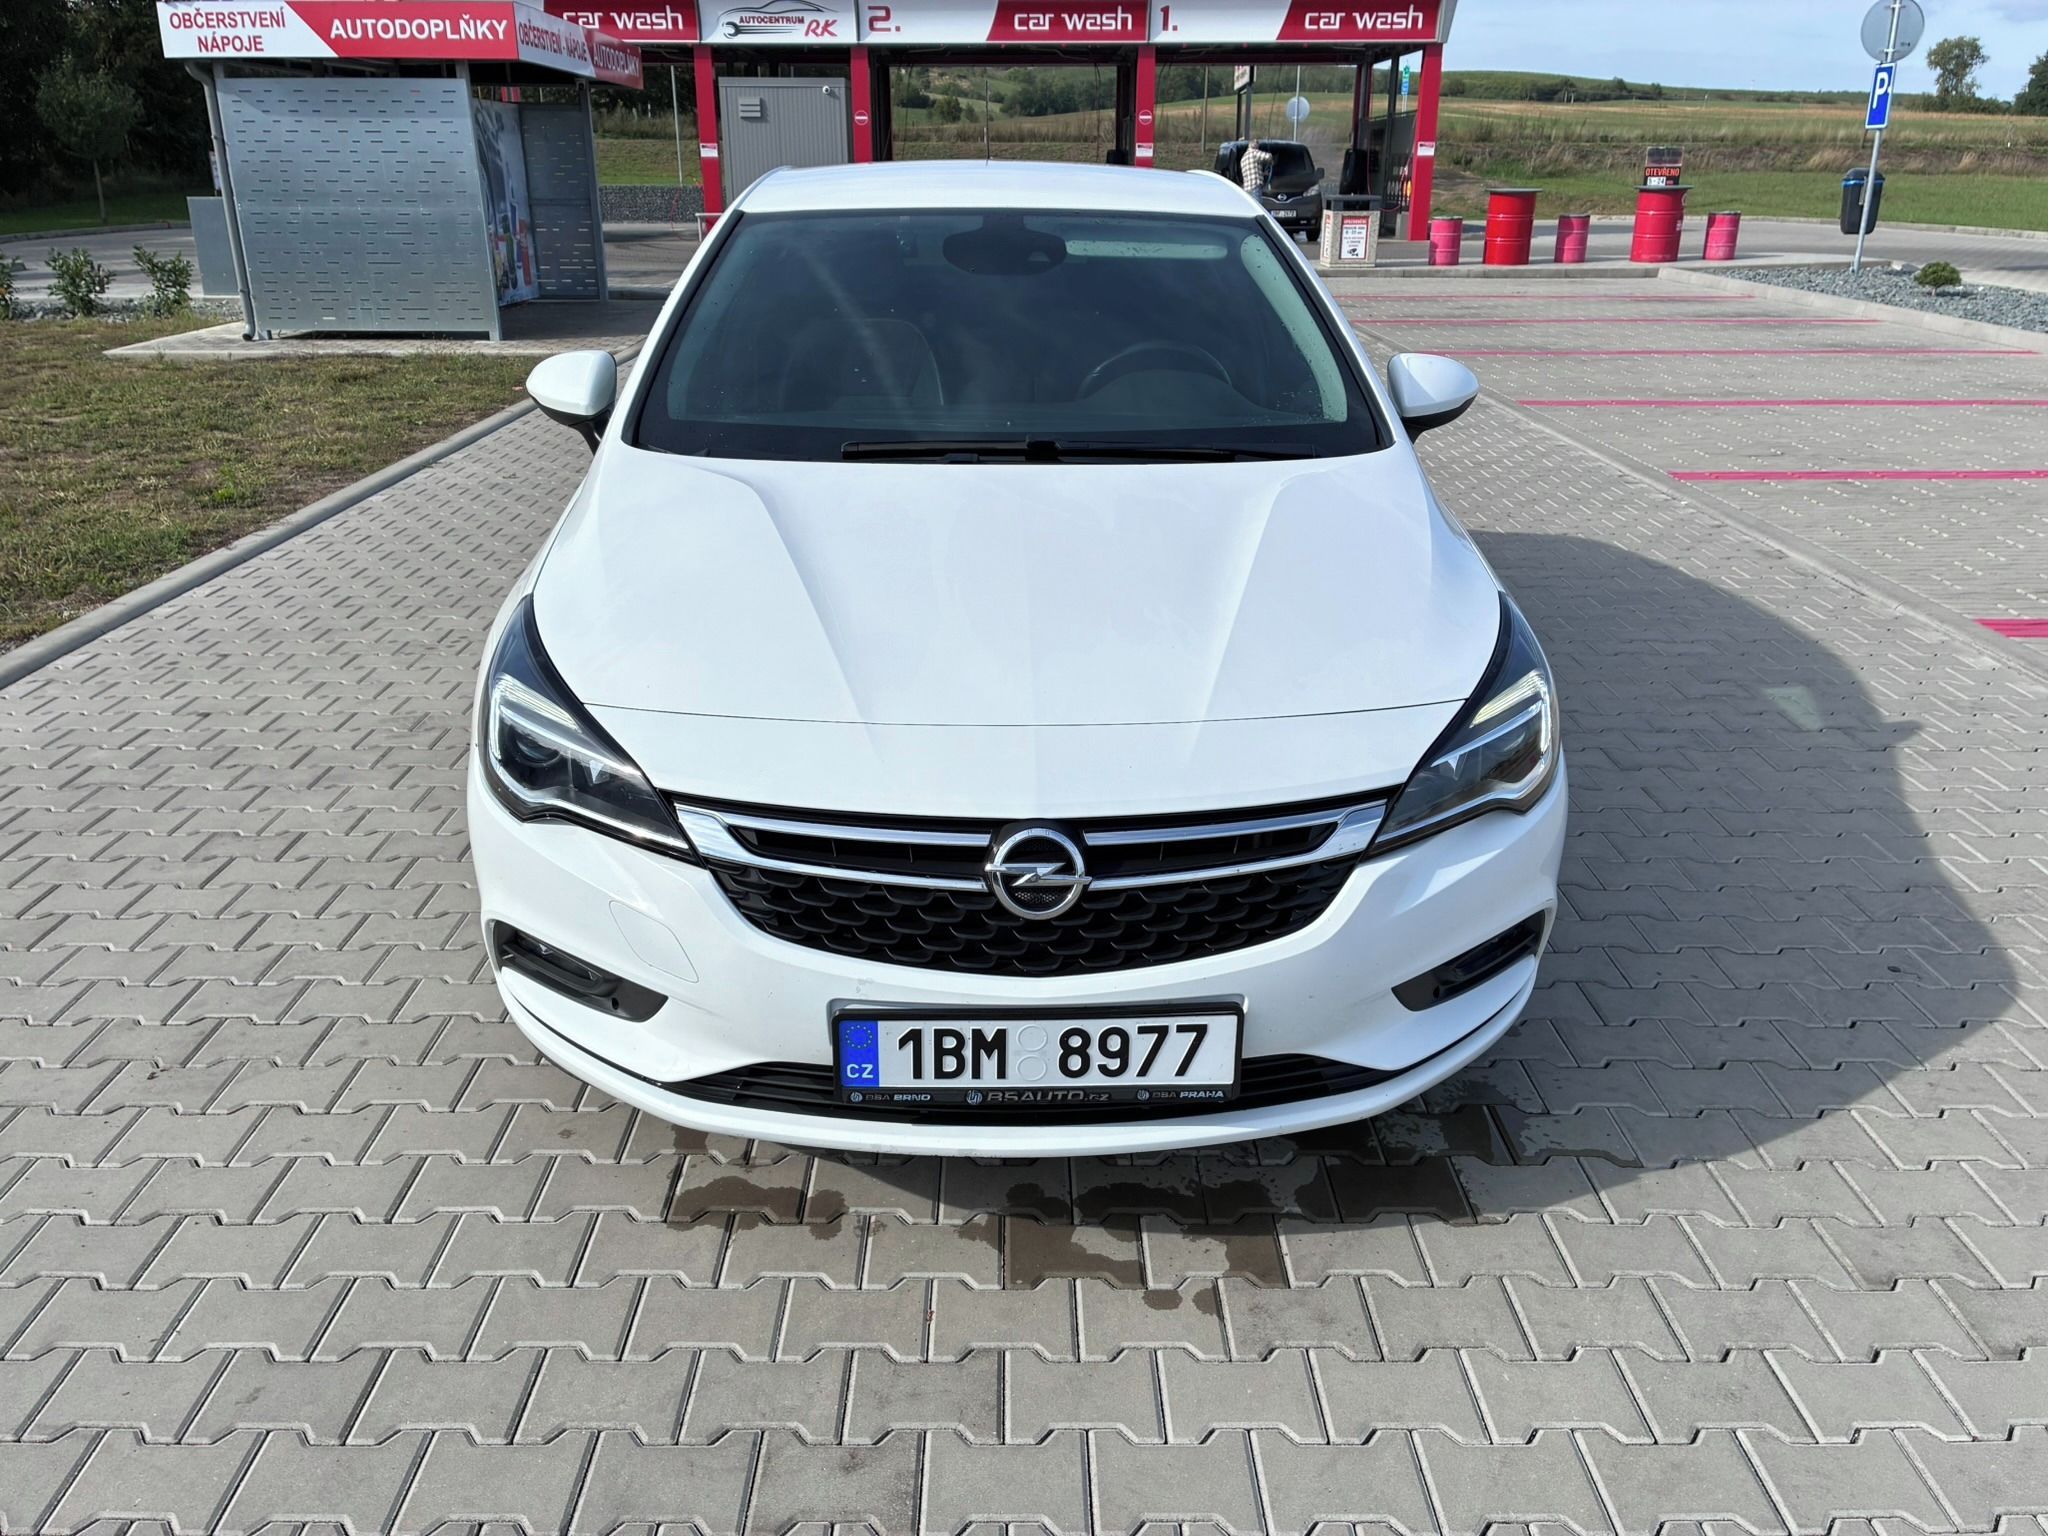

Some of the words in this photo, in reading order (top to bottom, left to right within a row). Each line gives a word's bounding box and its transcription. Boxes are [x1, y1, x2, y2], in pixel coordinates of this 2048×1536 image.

[169, 6, 286, 29] OBČERSTVENÍ
[330, 13, 508, 40] AUTODOPLŇKY
[610, 5, 684, 30] wash
[739, 15, 805, 25] AUTOCENTRUM
[805, 19, 838, 37] RK
[867, 5, 901, 32] 2.
[1014, 13, 1054, 30] car
[1061, 5, 1133, 30] wash
[1160, 5, 1178, 32] 1.
[1304, 12, 1346, 30] car
[1352, 4, 1424, 30] wash
[197, 31, 264, 53] NÁPOJE
[518, 18, 562, 55] OBČERSTVENÍ
[1872, 71, 1889, 110] P
[897, 1027, 1007, 1080] 1BM
[1058, 1023, 1208, 1079] 8977
[846, 1064, 874, 1079] CZ
[1180, 1090, 1224, 1098] PRAHA
